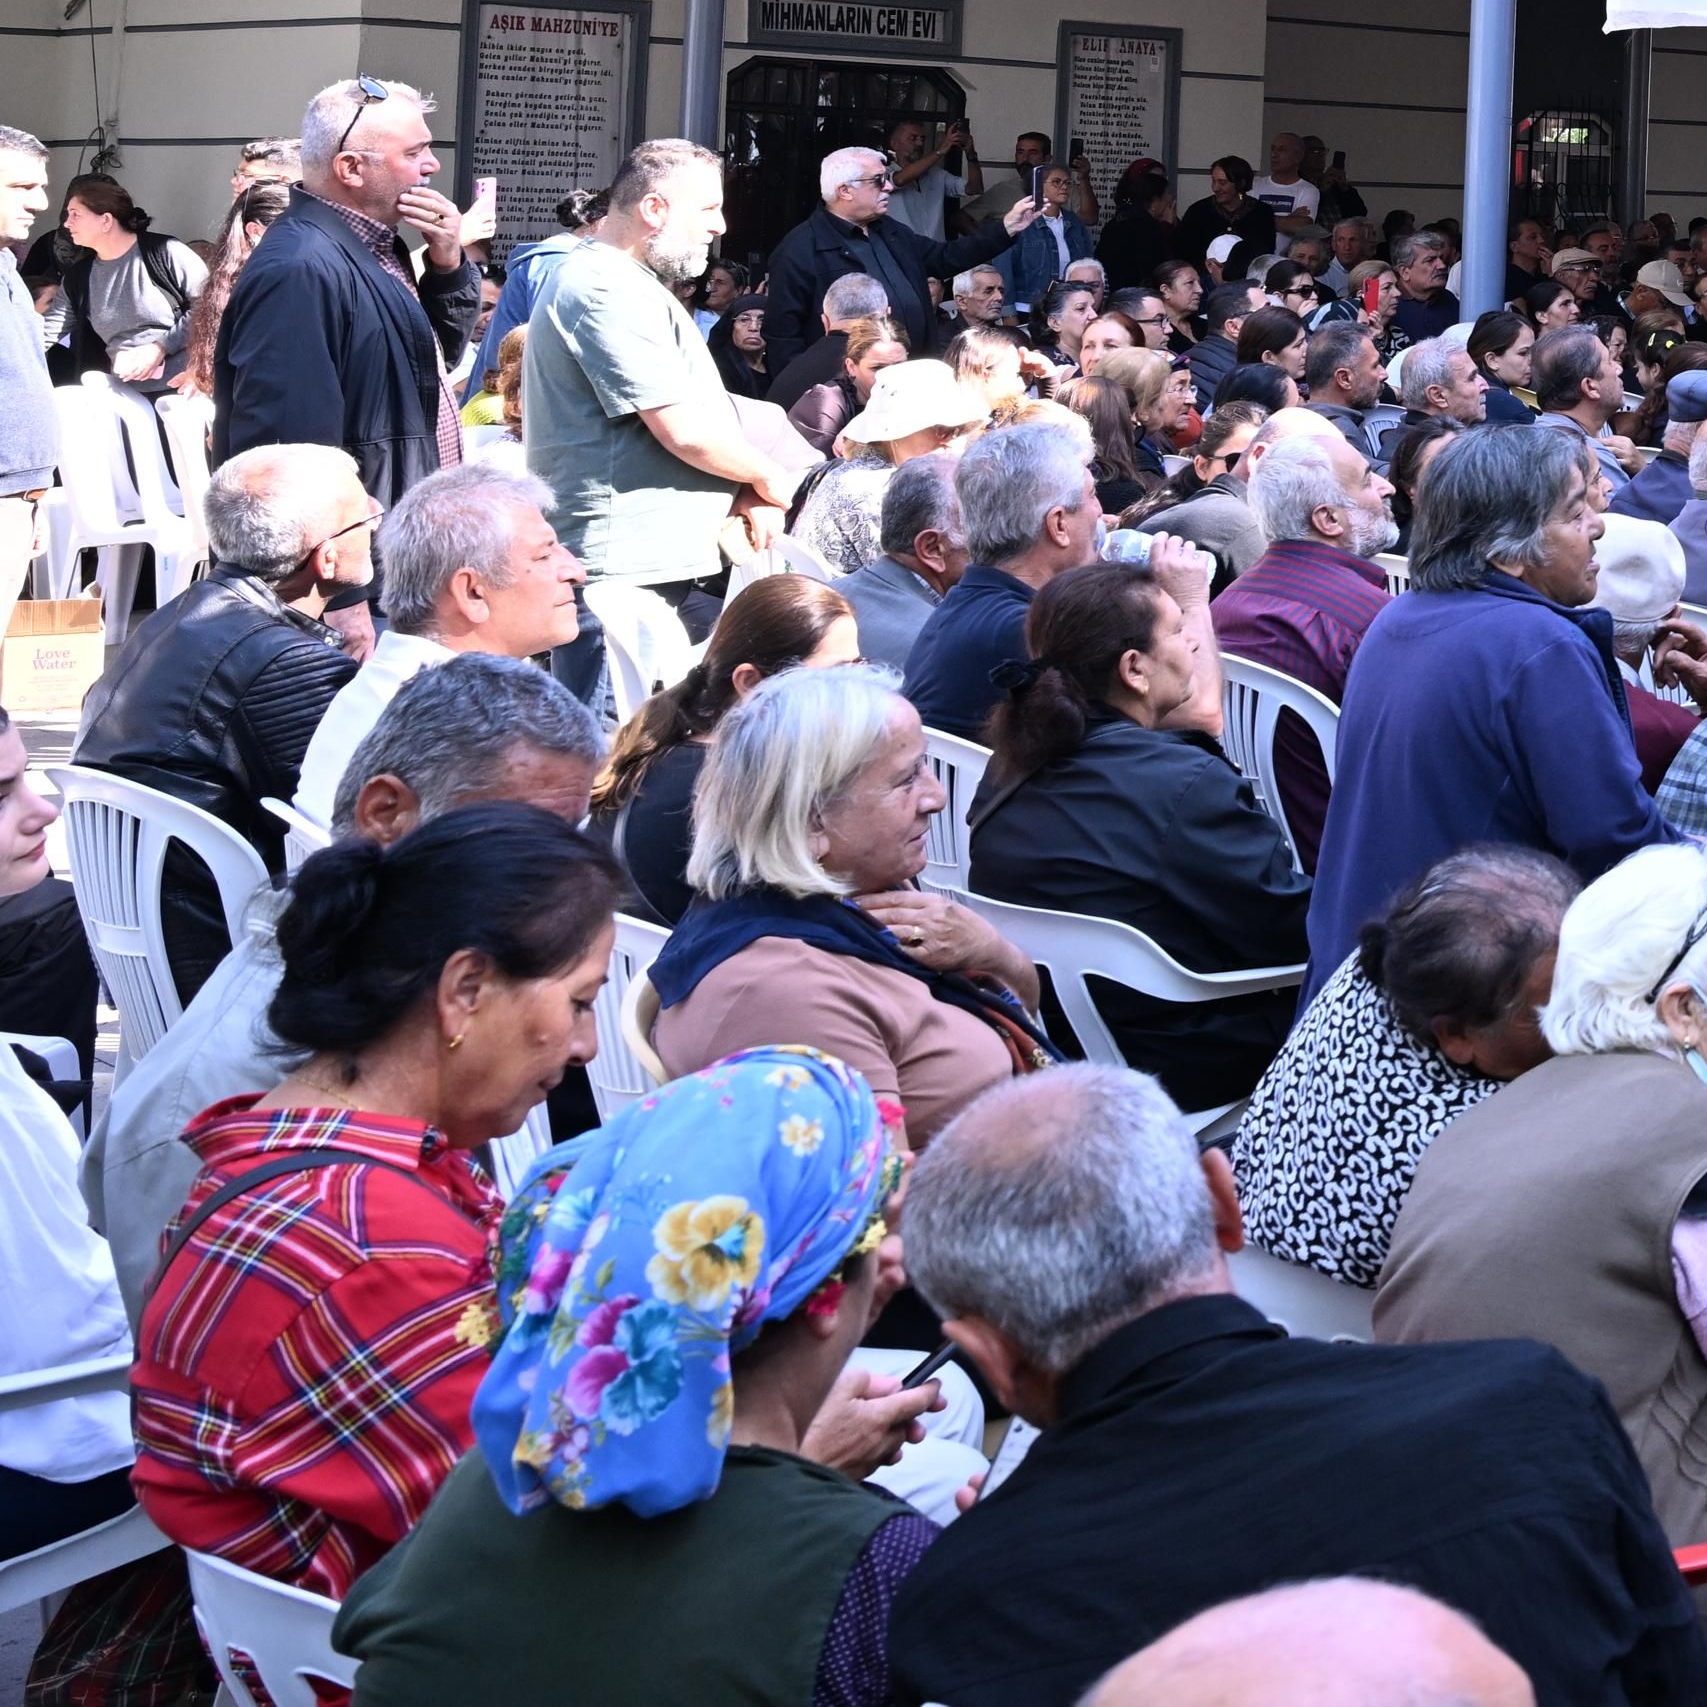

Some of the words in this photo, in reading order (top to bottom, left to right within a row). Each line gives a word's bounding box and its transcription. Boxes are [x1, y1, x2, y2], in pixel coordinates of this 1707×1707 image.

[490, 14, 526, 34] AŞIK
[530, 17, 619, 37] MAHZUNİ'YE
[762, 0, 872, 34] MİHMANLARIN
[876, 9, 908, 37] CEM
[1120, 39, 1156, 55] ANAYA
[35, 648, 70, 660] Love
[32, 659, 74, 670] Water
